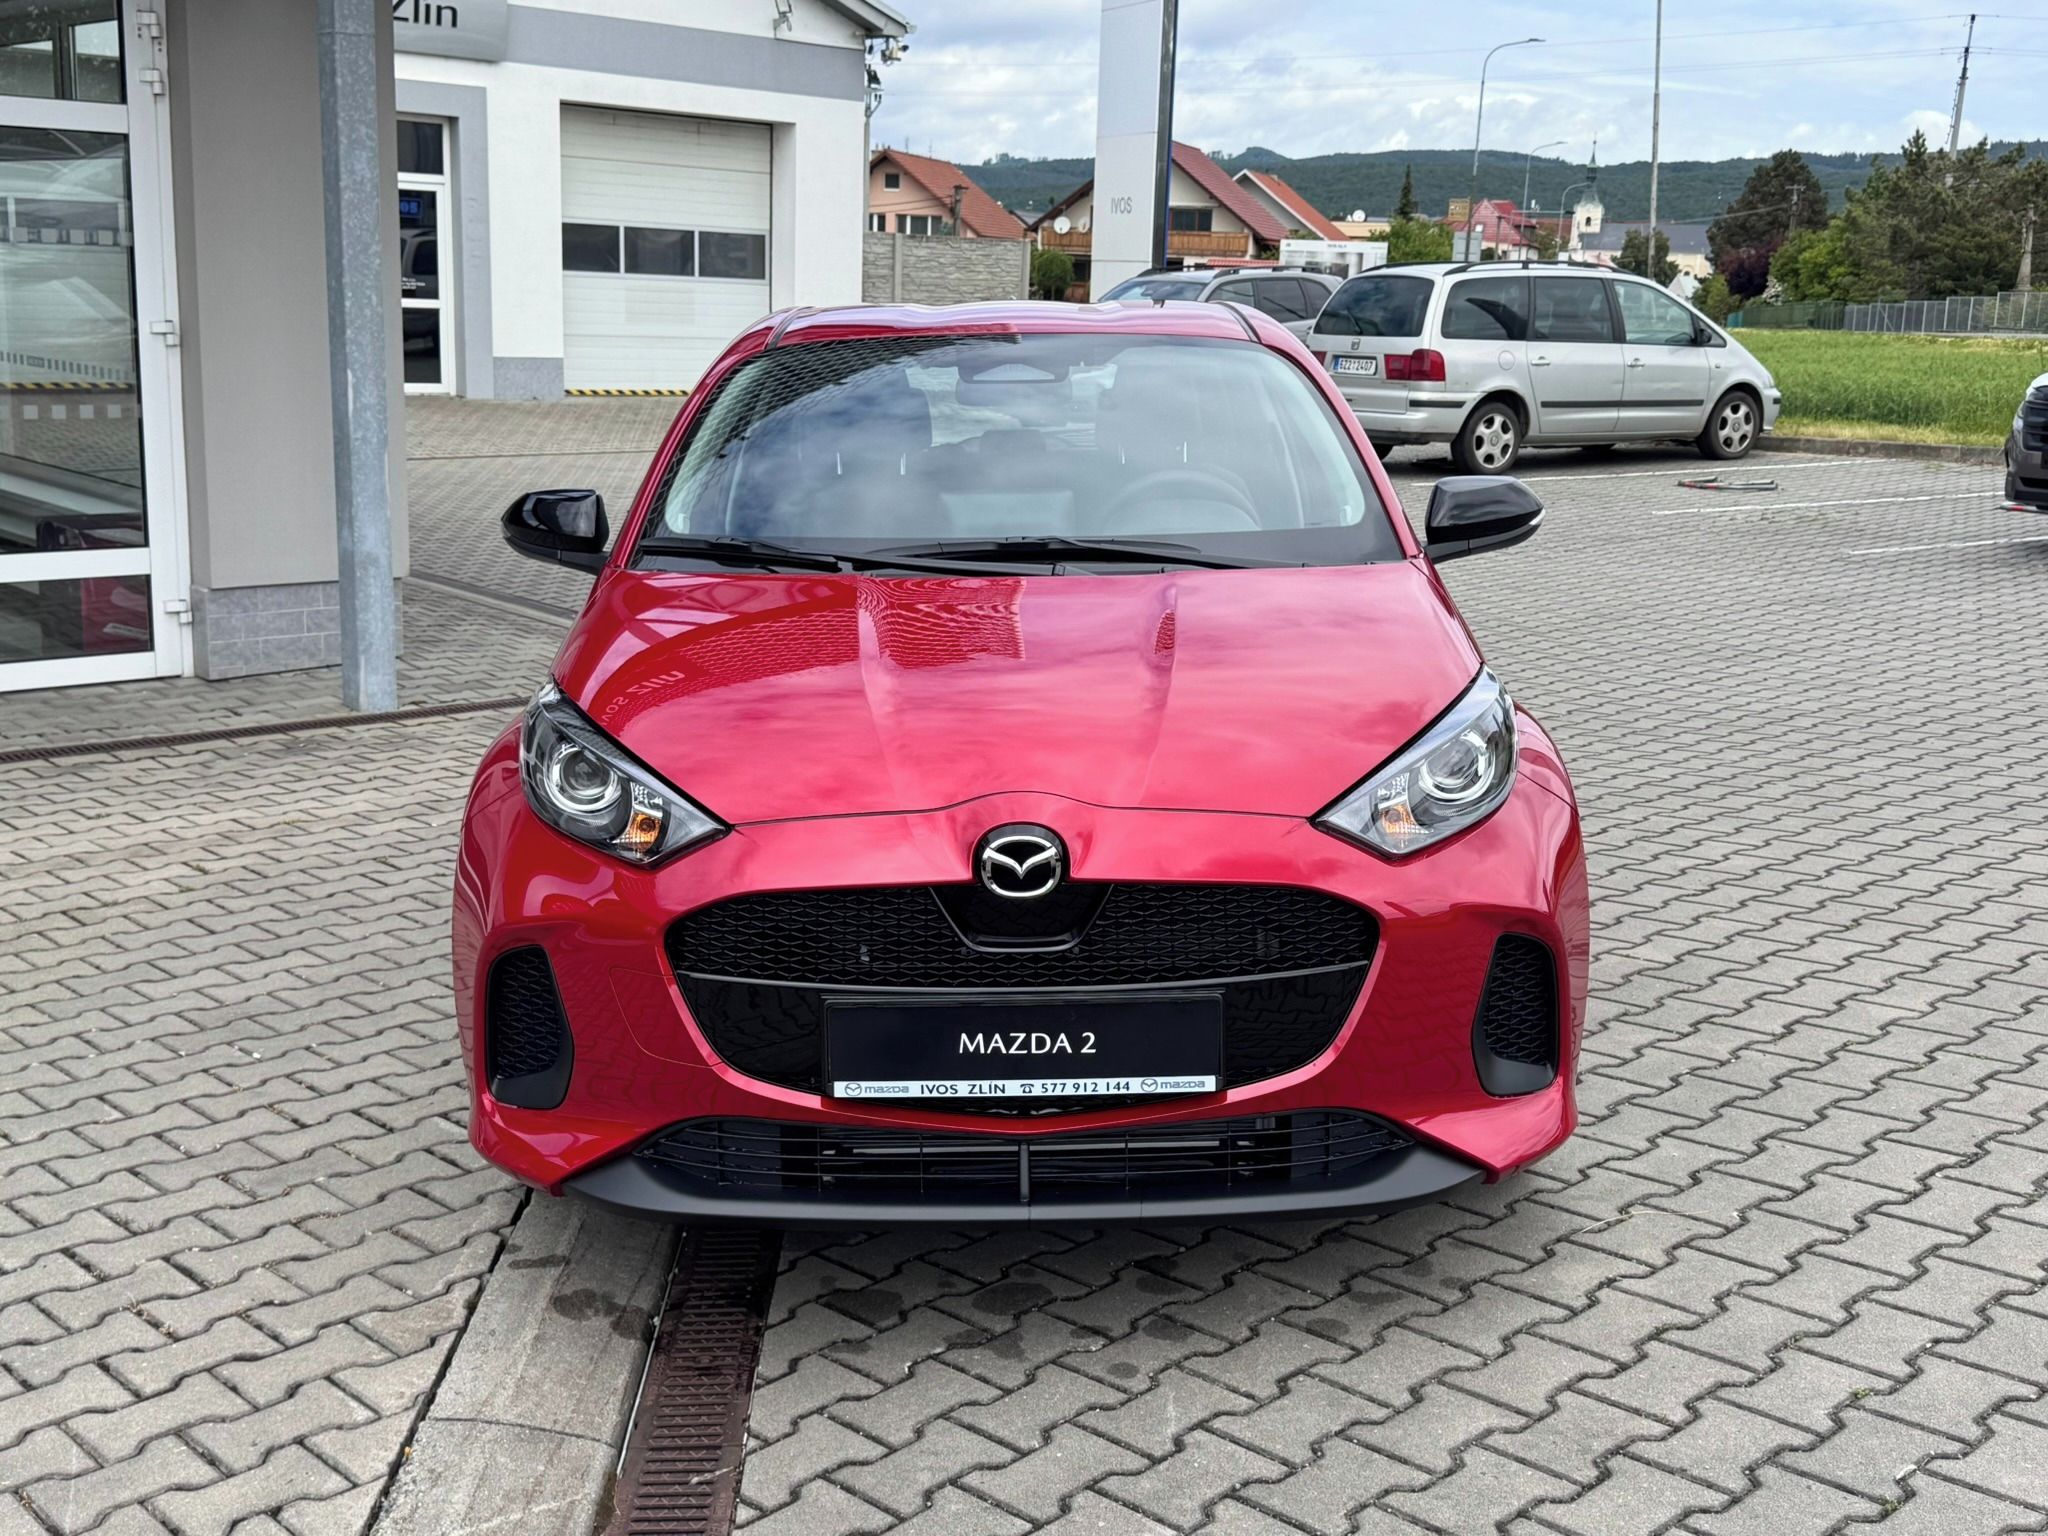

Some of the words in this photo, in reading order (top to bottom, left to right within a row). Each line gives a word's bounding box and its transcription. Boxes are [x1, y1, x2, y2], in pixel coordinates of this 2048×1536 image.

[1110, 196, 1132, 214] IVOS
[958, 1032, 1073, 1054] MAZDA
[1080, 1031, 1097, 1054] 2
[920, 1083, 959, 1096] IVOS
[967, 1081, 1006, 1095] ZLÍN
[1040, 1082, 1067, 1094] 577
[1072, 1081, 1099, 1093] 912
[1106, 1080, 1130, 1092] 144
